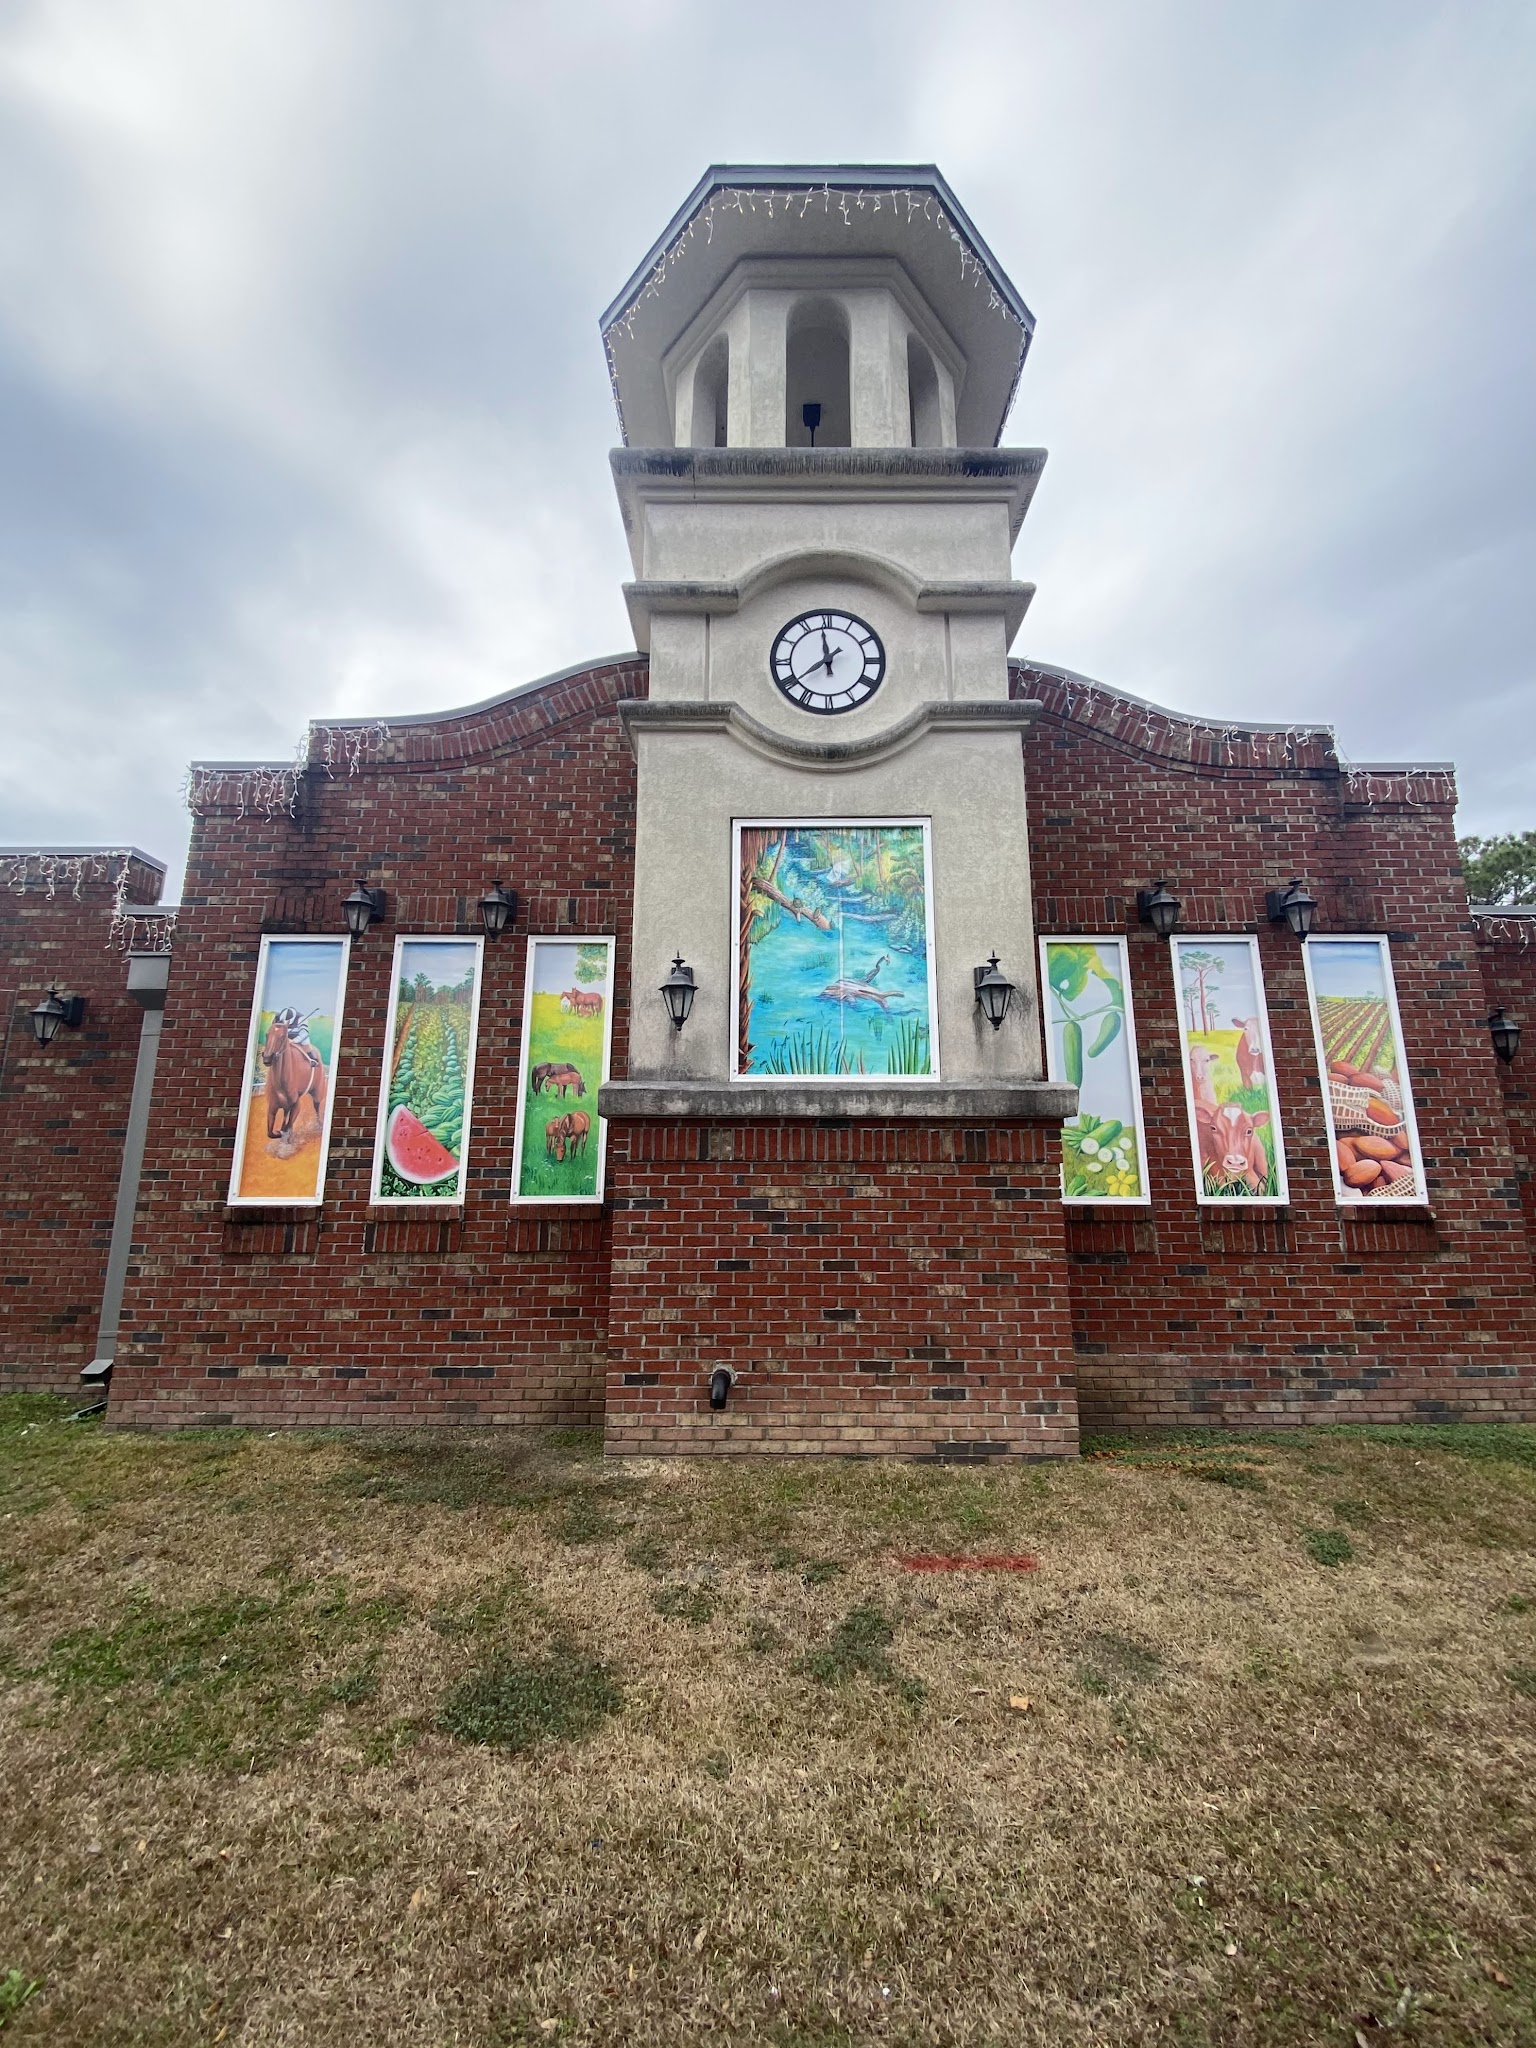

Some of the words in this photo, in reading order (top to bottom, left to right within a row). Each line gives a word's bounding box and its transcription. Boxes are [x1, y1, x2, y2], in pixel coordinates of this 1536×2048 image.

[846, 620, 853, 632] I
[781, 636, 796, 646] X
[859, 635, 873, 646] II
[846, 690, 857, 703] V
